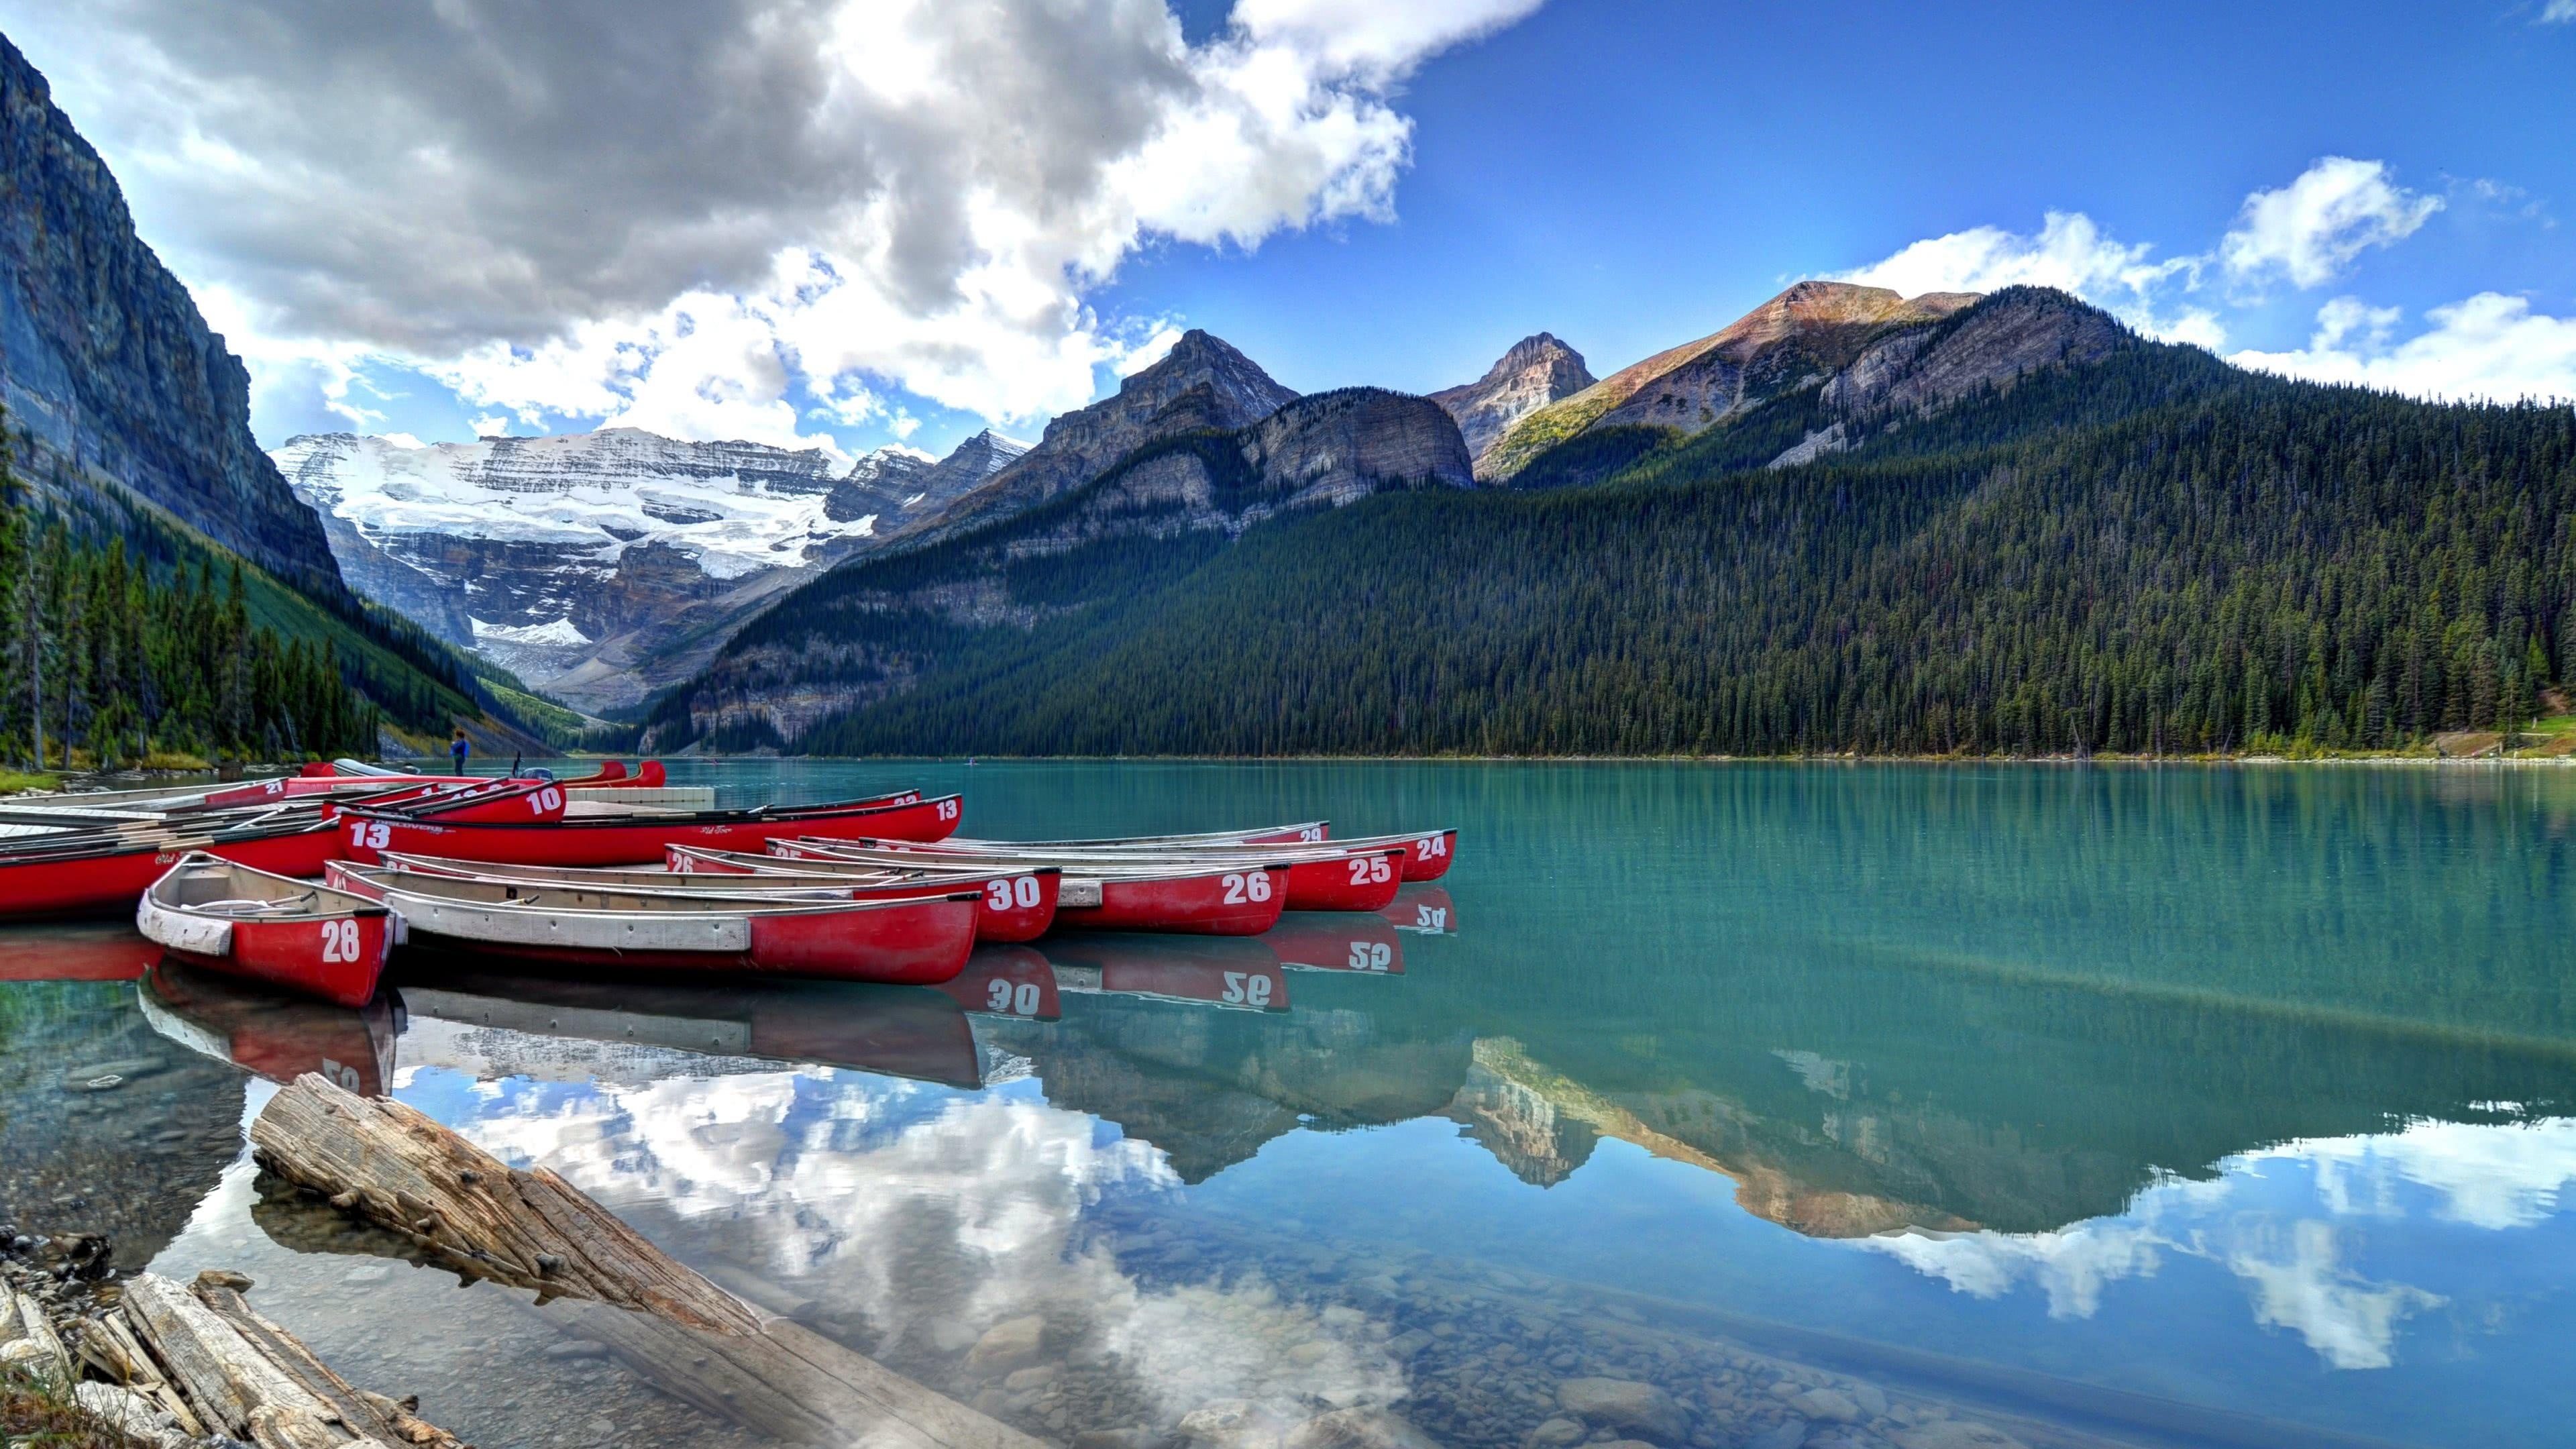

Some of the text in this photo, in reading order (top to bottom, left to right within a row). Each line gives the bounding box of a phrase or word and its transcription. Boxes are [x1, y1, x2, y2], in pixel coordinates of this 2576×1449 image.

[266, 782, 283, 794] 21
[527, 787, 561, 815] 10
[936, 800, 957, 821] 13
[350, 822, 390, 849] 13
[1300, 827, 1322, 842] 29
[1417, 836, 1446, 861] 24
[673, 853, 693, 872] 26
[1348, 856, 1391, 885] 25
[987, 876, 1040, 910] 30
[1222, 871, 1271, 905] 26
[321, 919, 360, 963] 28
